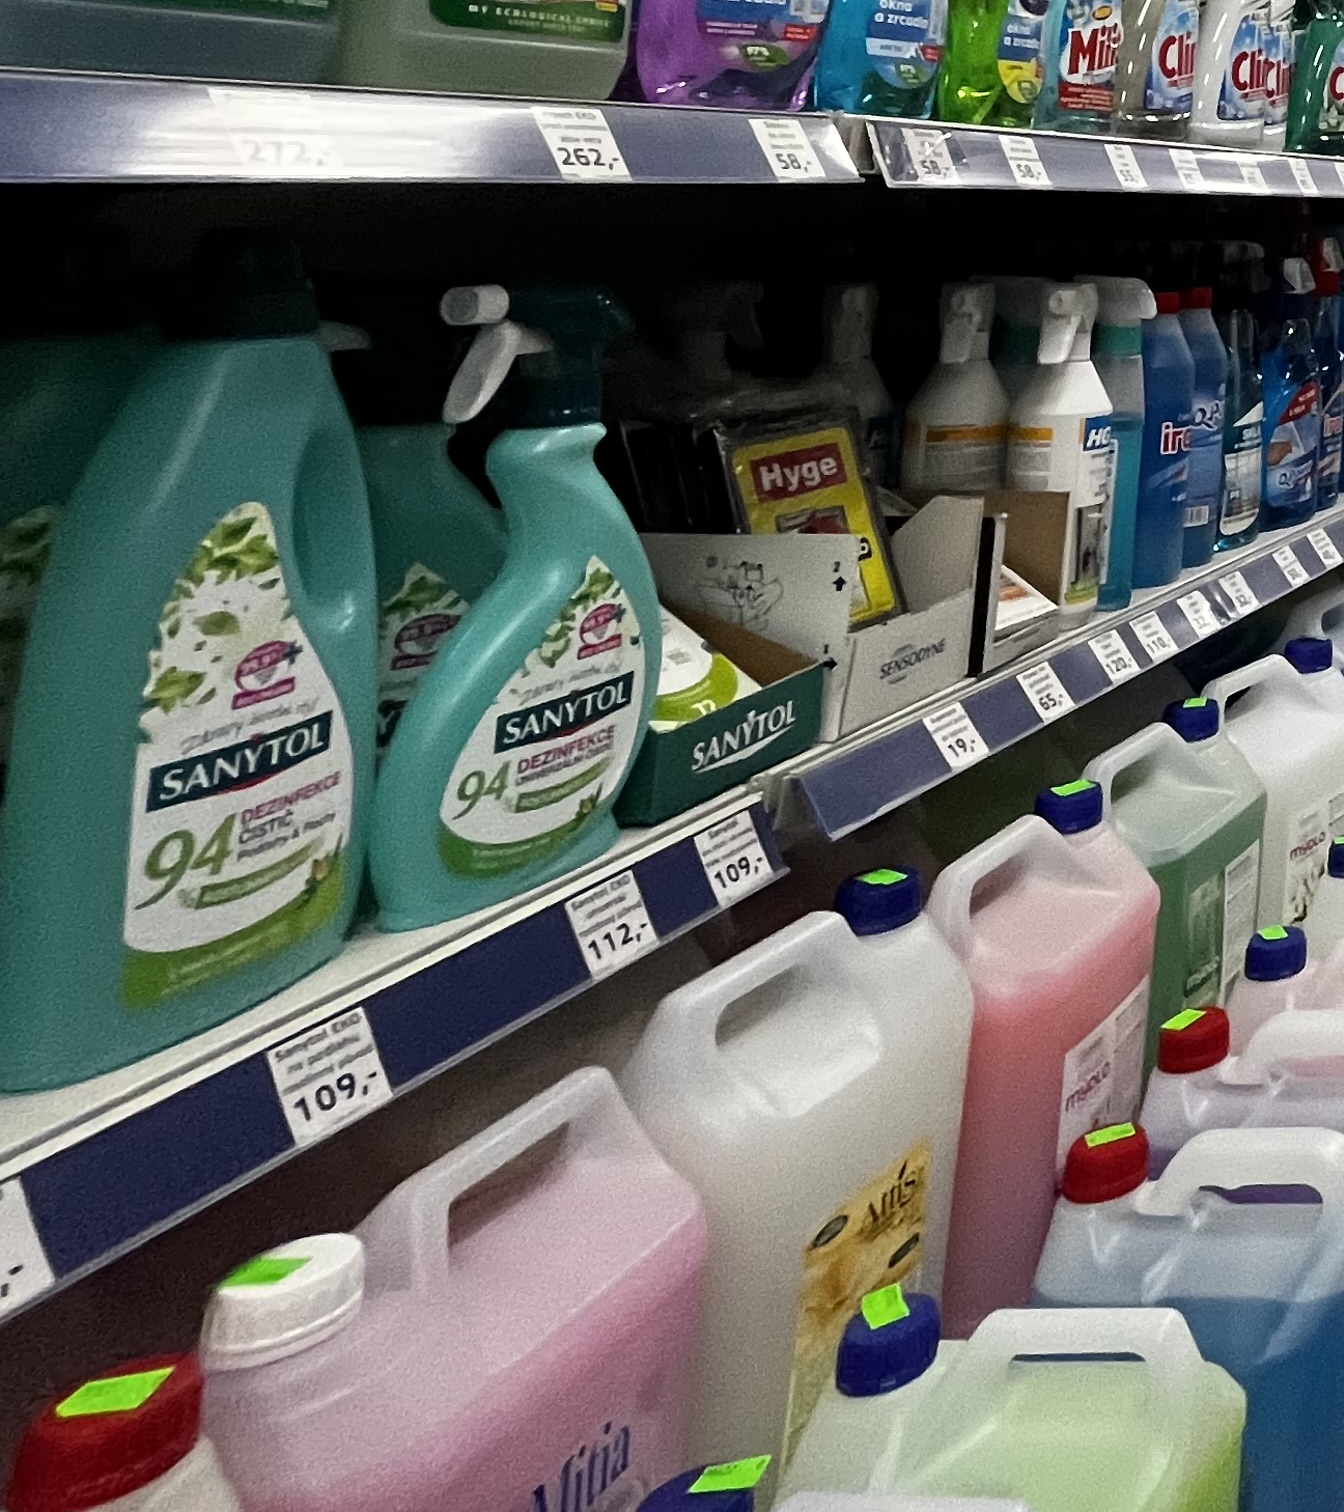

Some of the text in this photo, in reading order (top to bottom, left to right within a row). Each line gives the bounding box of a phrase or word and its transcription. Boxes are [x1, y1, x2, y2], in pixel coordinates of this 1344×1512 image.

[557, 145, 620, 172] 262,-
[774, 152, 814, 173] 58,-
[503, 678, 629, 745] SANYTOL
[1038, 693, 1066, 711] 65,-
[516, 724, 617, 775] DEZINFEKCE
[690, 700, 796, 772] SANYTOL
[946, 738, 977, 761] 19,-
[159, 726, 326, 801] SANYTOL
[240, 771, 341, 825] DEZINFEKCE
[452, 760, 512, 820] 94
[134, 814, 236, 911] 94
[714, 856, 765, 889] 109,-
[586, 921, 649, 961] 112,-
[293, 1070, 379, 1124] 109,-
